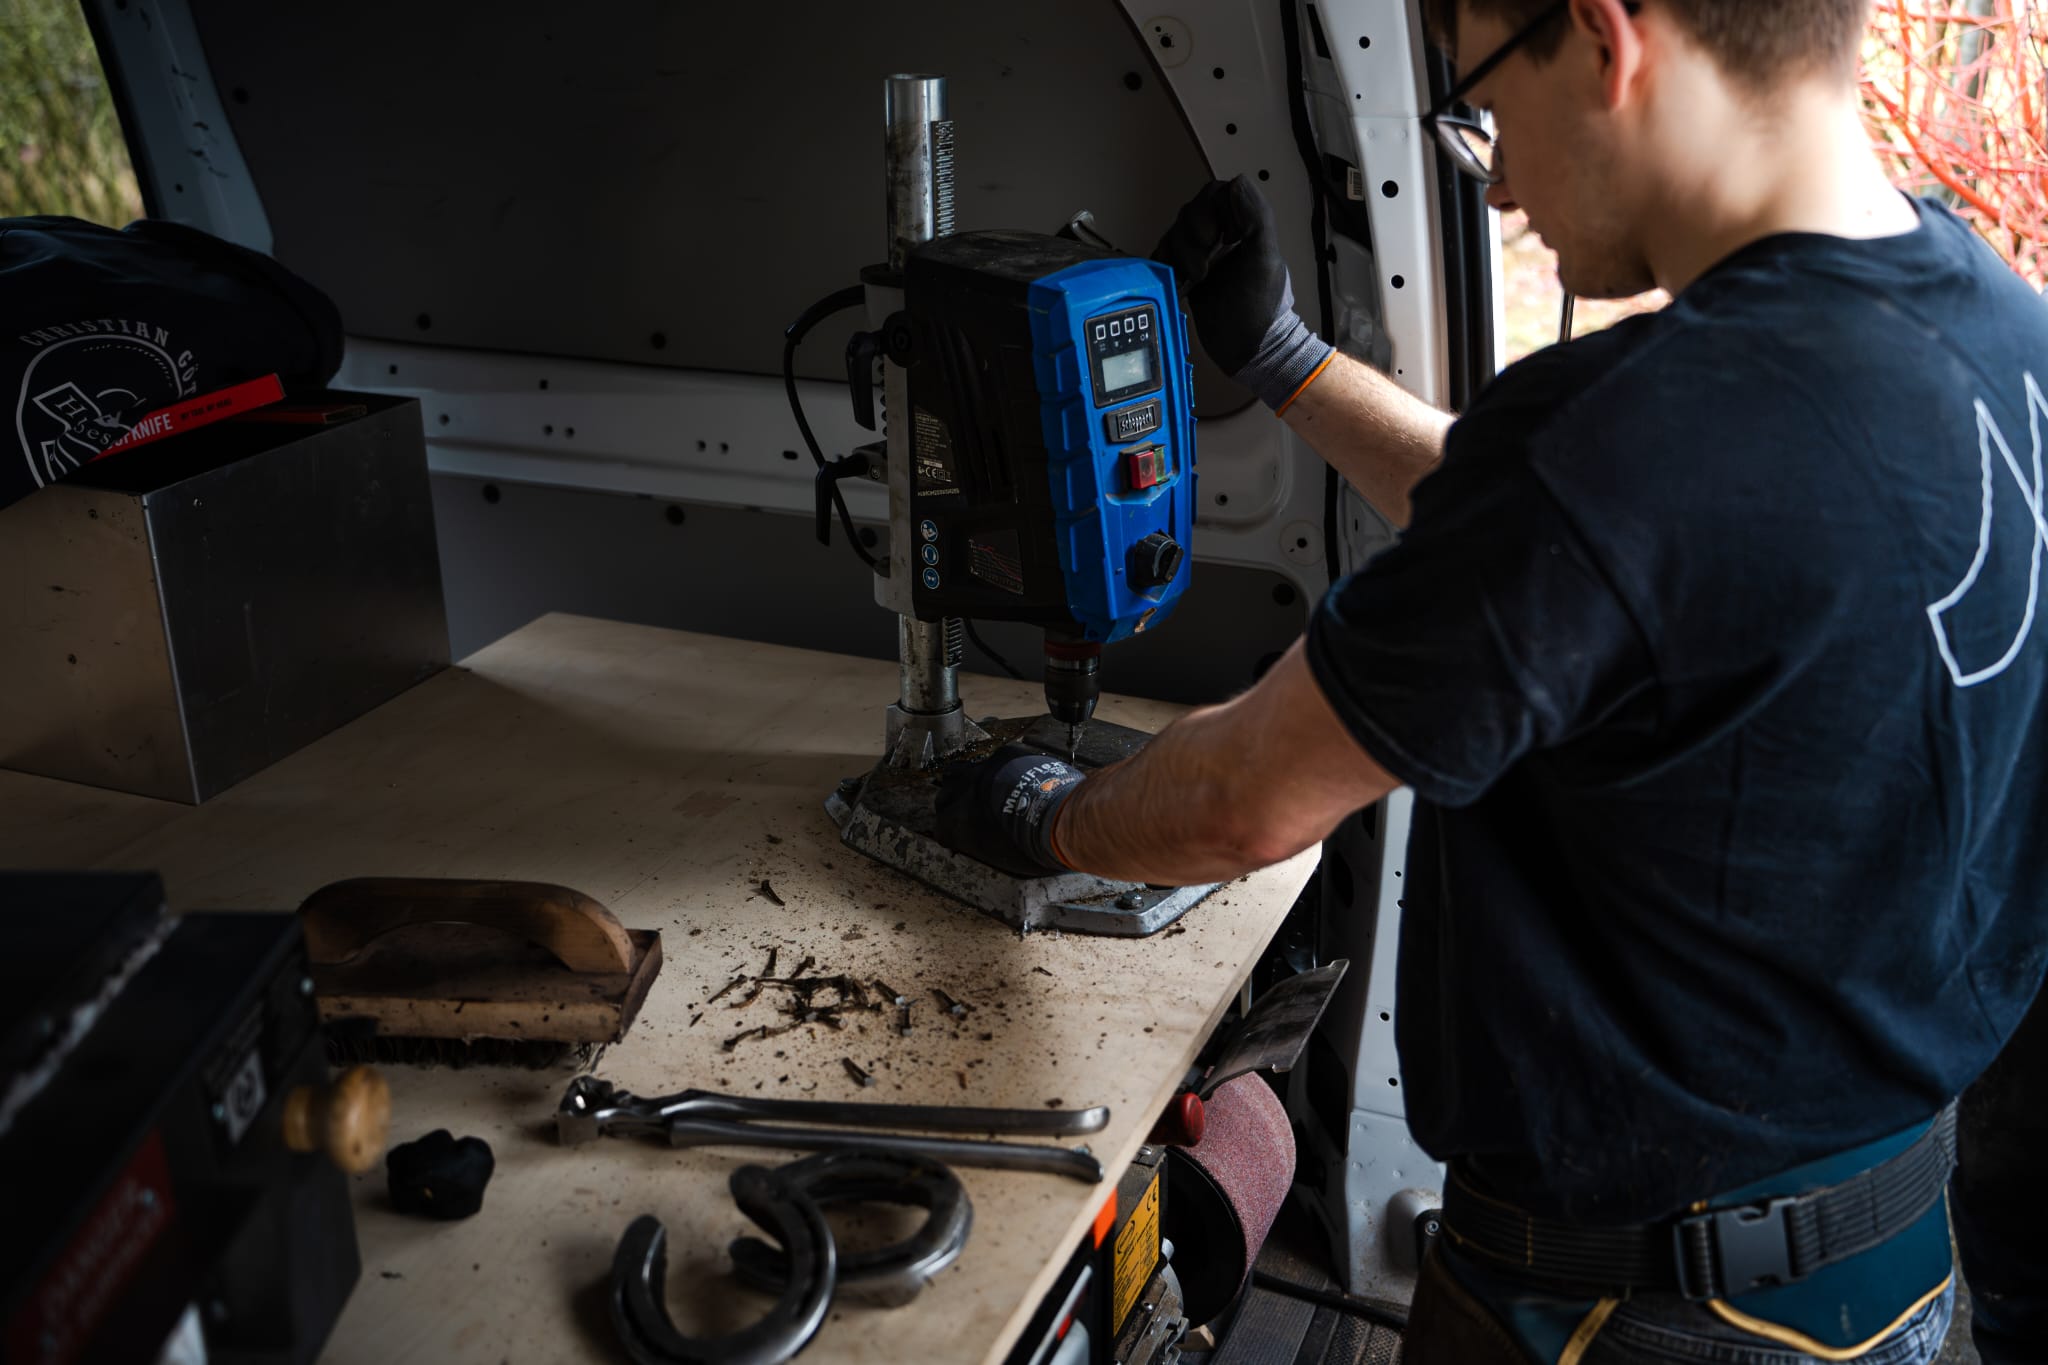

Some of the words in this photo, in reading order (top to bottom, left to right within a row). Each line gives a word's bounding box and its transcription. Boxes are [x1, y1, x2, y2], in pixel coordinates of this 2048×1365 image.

[19, 319, 170, 347] CHRISTIAN
[131, 412, 174, 441] KNIFE
[1121, 406, 1154, 433] scheppach
[1002, 760, 1063, 814] MaxiFlex
